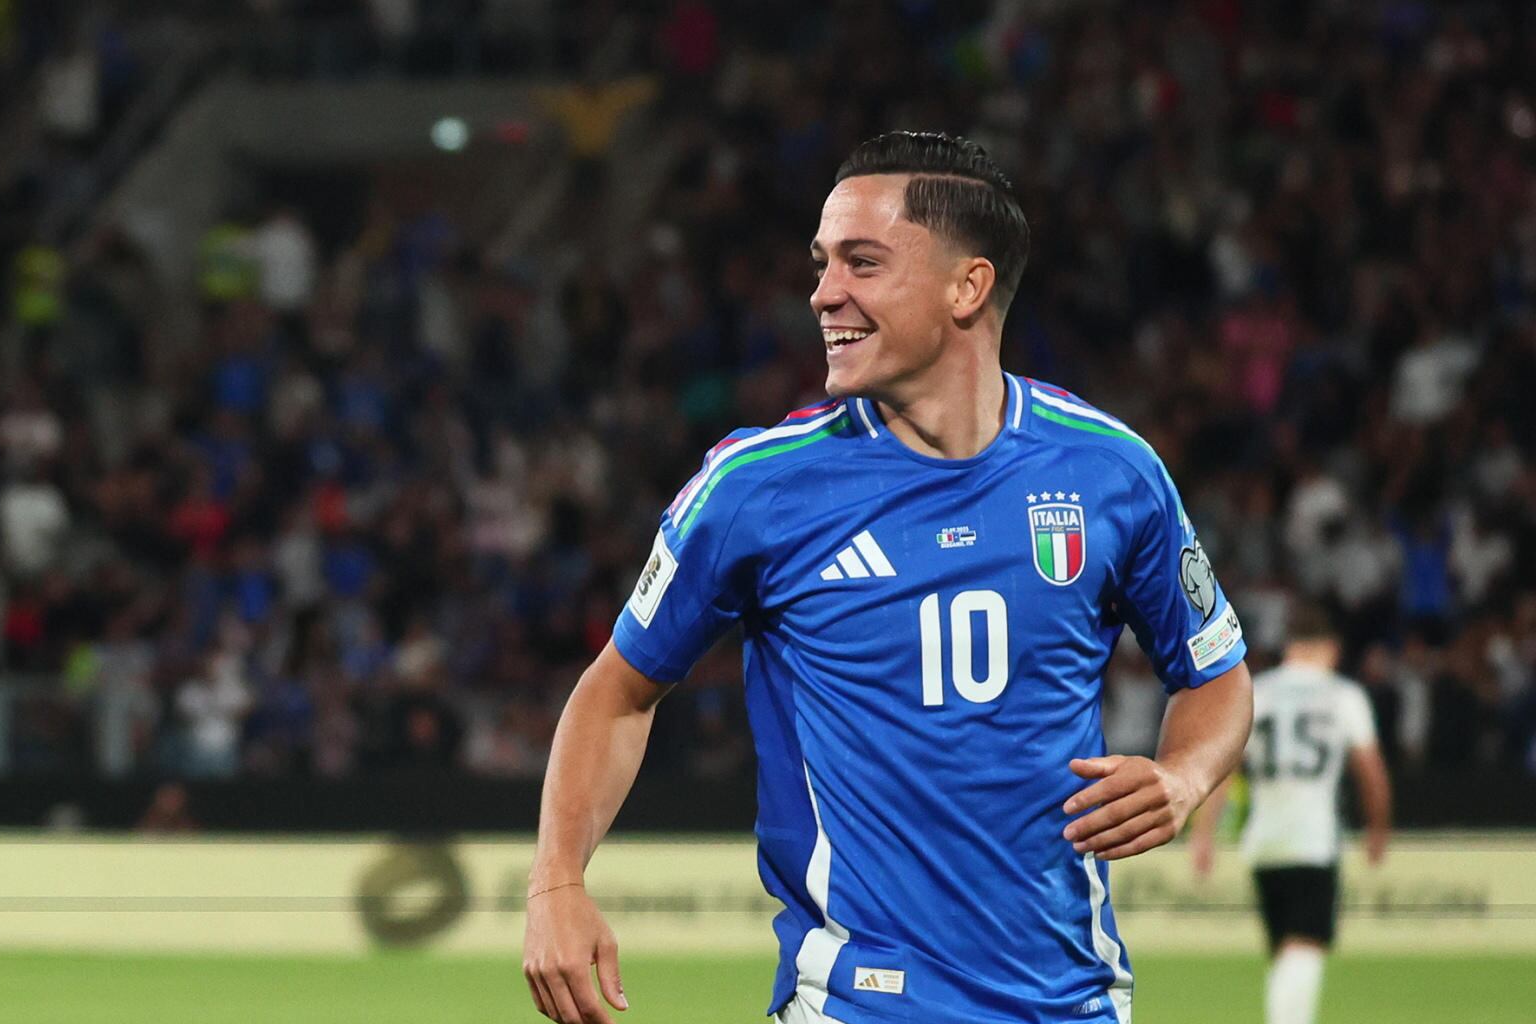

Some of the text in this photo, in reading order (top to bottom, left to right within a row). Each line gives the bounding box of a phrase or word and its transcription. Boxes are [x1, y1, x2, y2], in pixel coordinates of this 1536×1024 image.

[1033, 510, 1080, 526] ITALIA
[919, 589, 1009, 706] 10
[1242, 711, 1334, 779] 15
